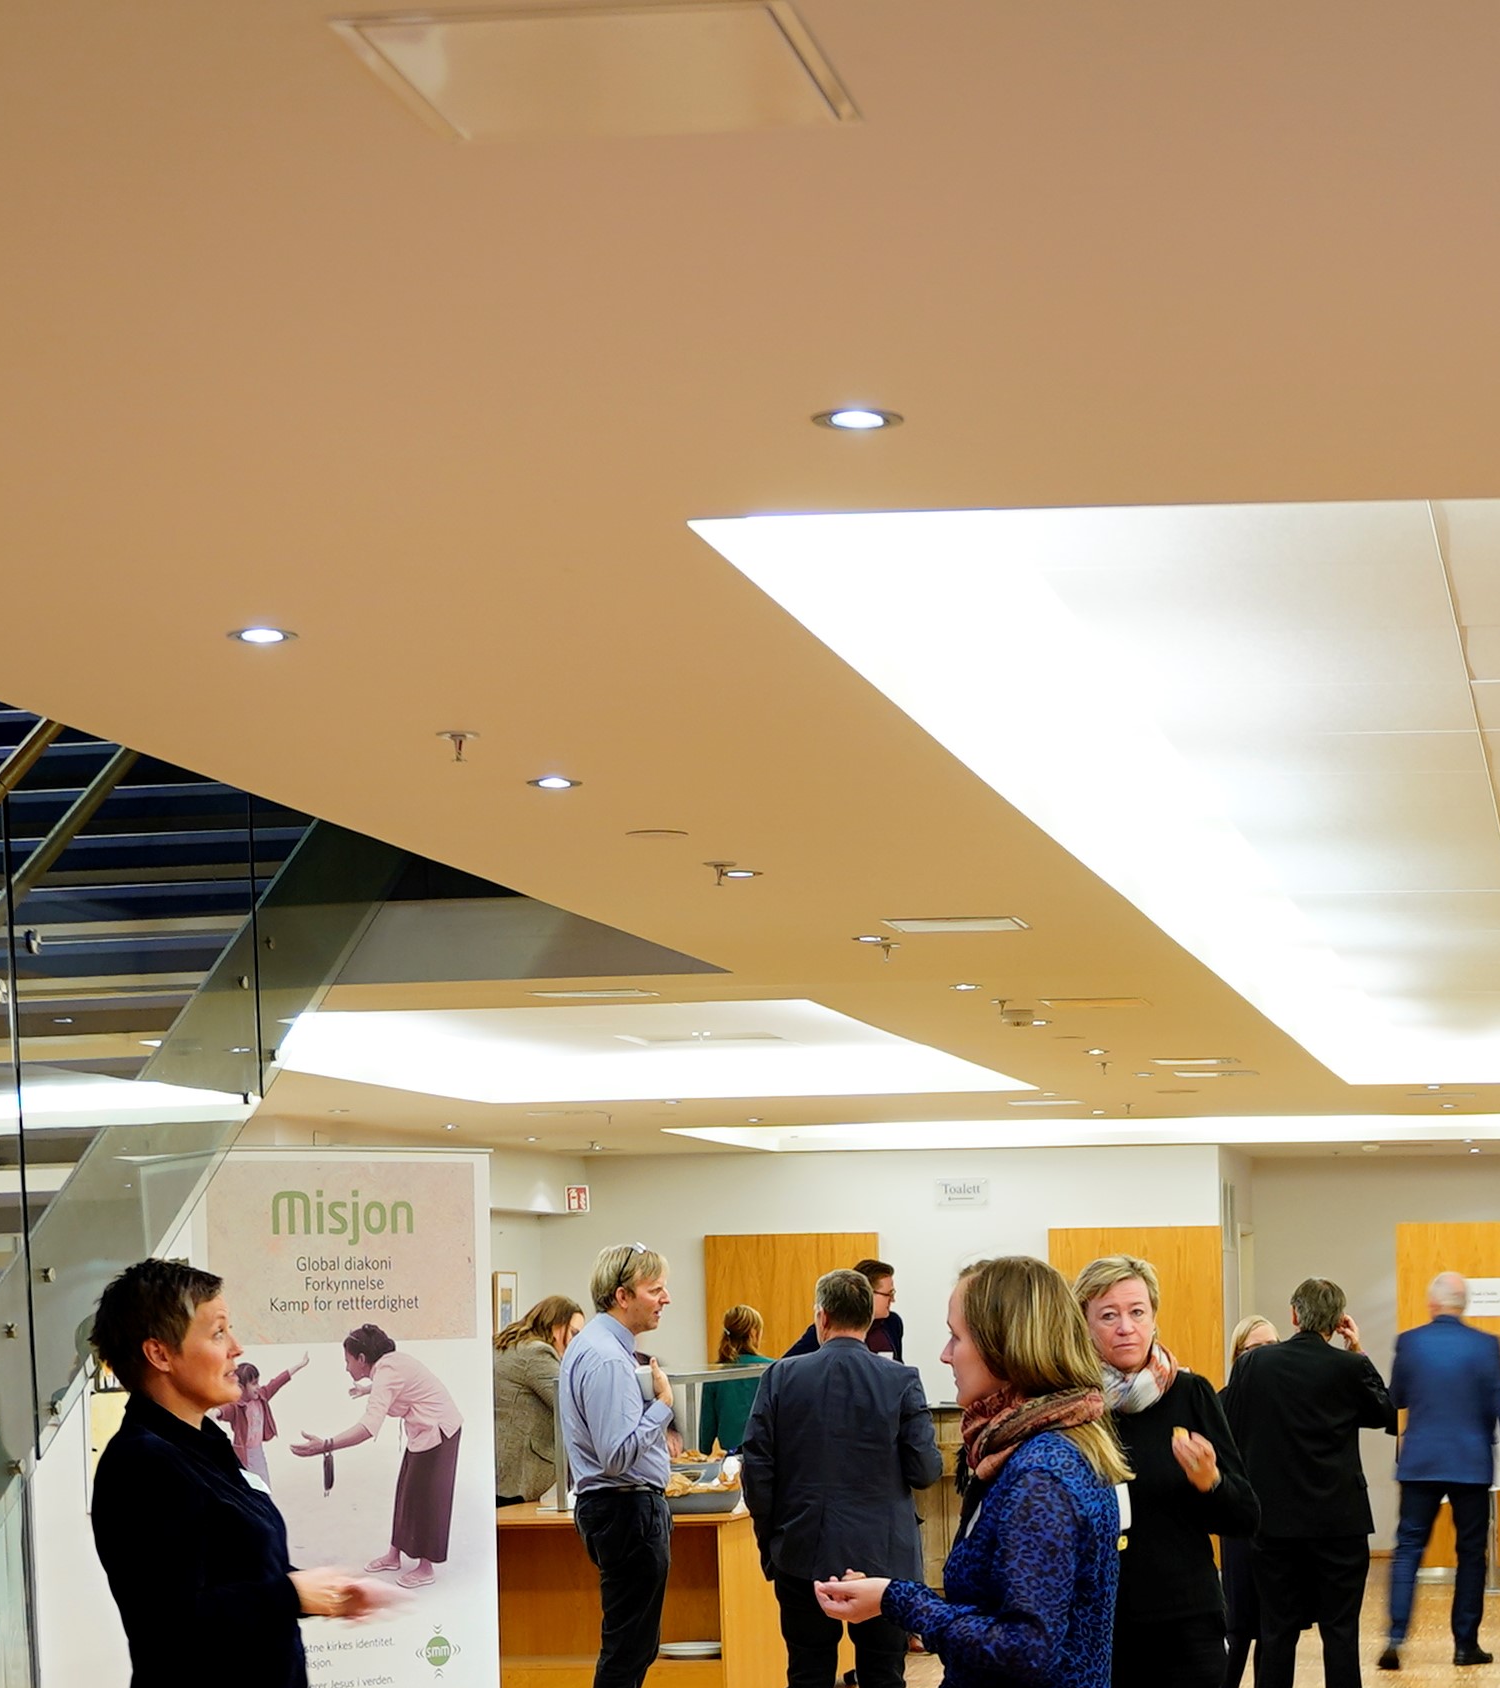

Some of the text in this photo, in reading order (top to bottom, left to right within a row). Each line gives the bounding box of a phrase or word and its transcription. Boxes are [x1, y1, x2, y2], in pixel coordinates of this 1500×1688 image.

[942, 1183, 980, 1194] Toalett
[271, 1189, 414, 1246] Misjon
[296, 1256, 392, 1272] Global diakoni
[305, 1276, 385, 1294] Forkynnelse
[269, 1295, 419, 1314] Kamp for rettferdighet
[304, 1643, 324, 1654] stne
[326, 1640, 353, 1651] kirkes
[426, 1644, 450, 1658] smm
